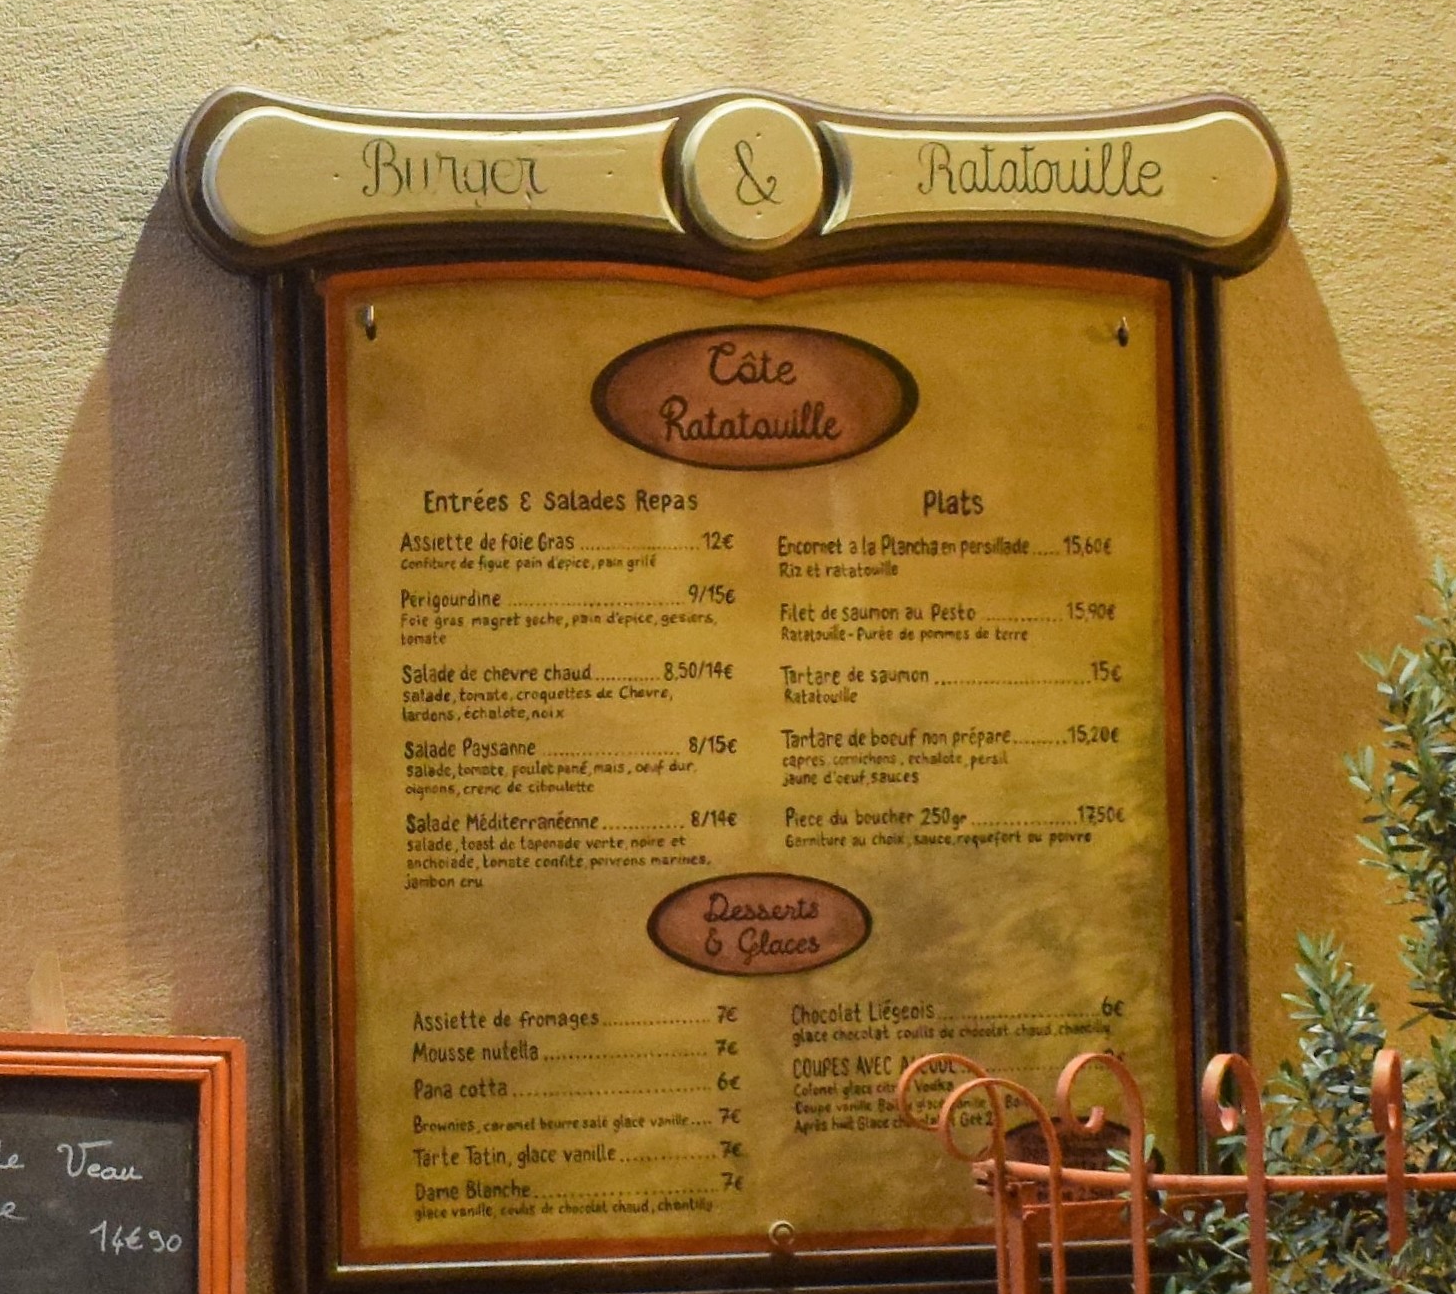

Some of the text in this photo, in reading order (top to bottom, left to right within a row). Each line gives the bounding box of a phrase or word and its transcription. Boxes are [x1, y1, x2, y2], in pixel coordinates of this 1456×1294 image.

[362, 138, 1164, 208] Burger & Ratatouille
[659, 394, 843, 442] Ratatouille
[423, 487, 509, 513] Entrées
[543, 489, 626, 511] Salades
[636, 489, 698, 513] Repas
[923, 489, 985, 516] Plats
[400, 532, 473, 551] Assiette
[480, 534, 496, 551] de
[537, 532, 575, 551] Gras
[703, 532, 734, 549] 12€
[862, 536, 876, 555] la
[881, 534, 939, 556] Plancha
[941, 541, 957, 555] en
[960, 537, 1030, 558] persillade
[1064, 536, 1112, 555] 15,60€
[779, 561, 898, 578] Riz et ratatouille
[688, 584, 736, 604] 9/15€
[402, 664, 455, 684] Salade
[460, 665, 477, 681] de
[543, 663, 591, 681] chaud
[781, 728, 843, 748] Tartare
[849, 728, 866, 746] de
[871, 727, 918, 746] boeuf
[922, 731, 947, 745] non
[1068, 726, 1119, 745] 15,20€
[703, 892, 820, 923] Desserts
[738, 927, 821, 965] Glaces
[413, 1006, 738, 1031] Assiette de fromages 7€
[412, 1040, 738, 1062] Mousse nutella 7€
[413, 1072, 741, 1100] Pana cotta 6€
[57, 1139, 143, 1181] Veau
